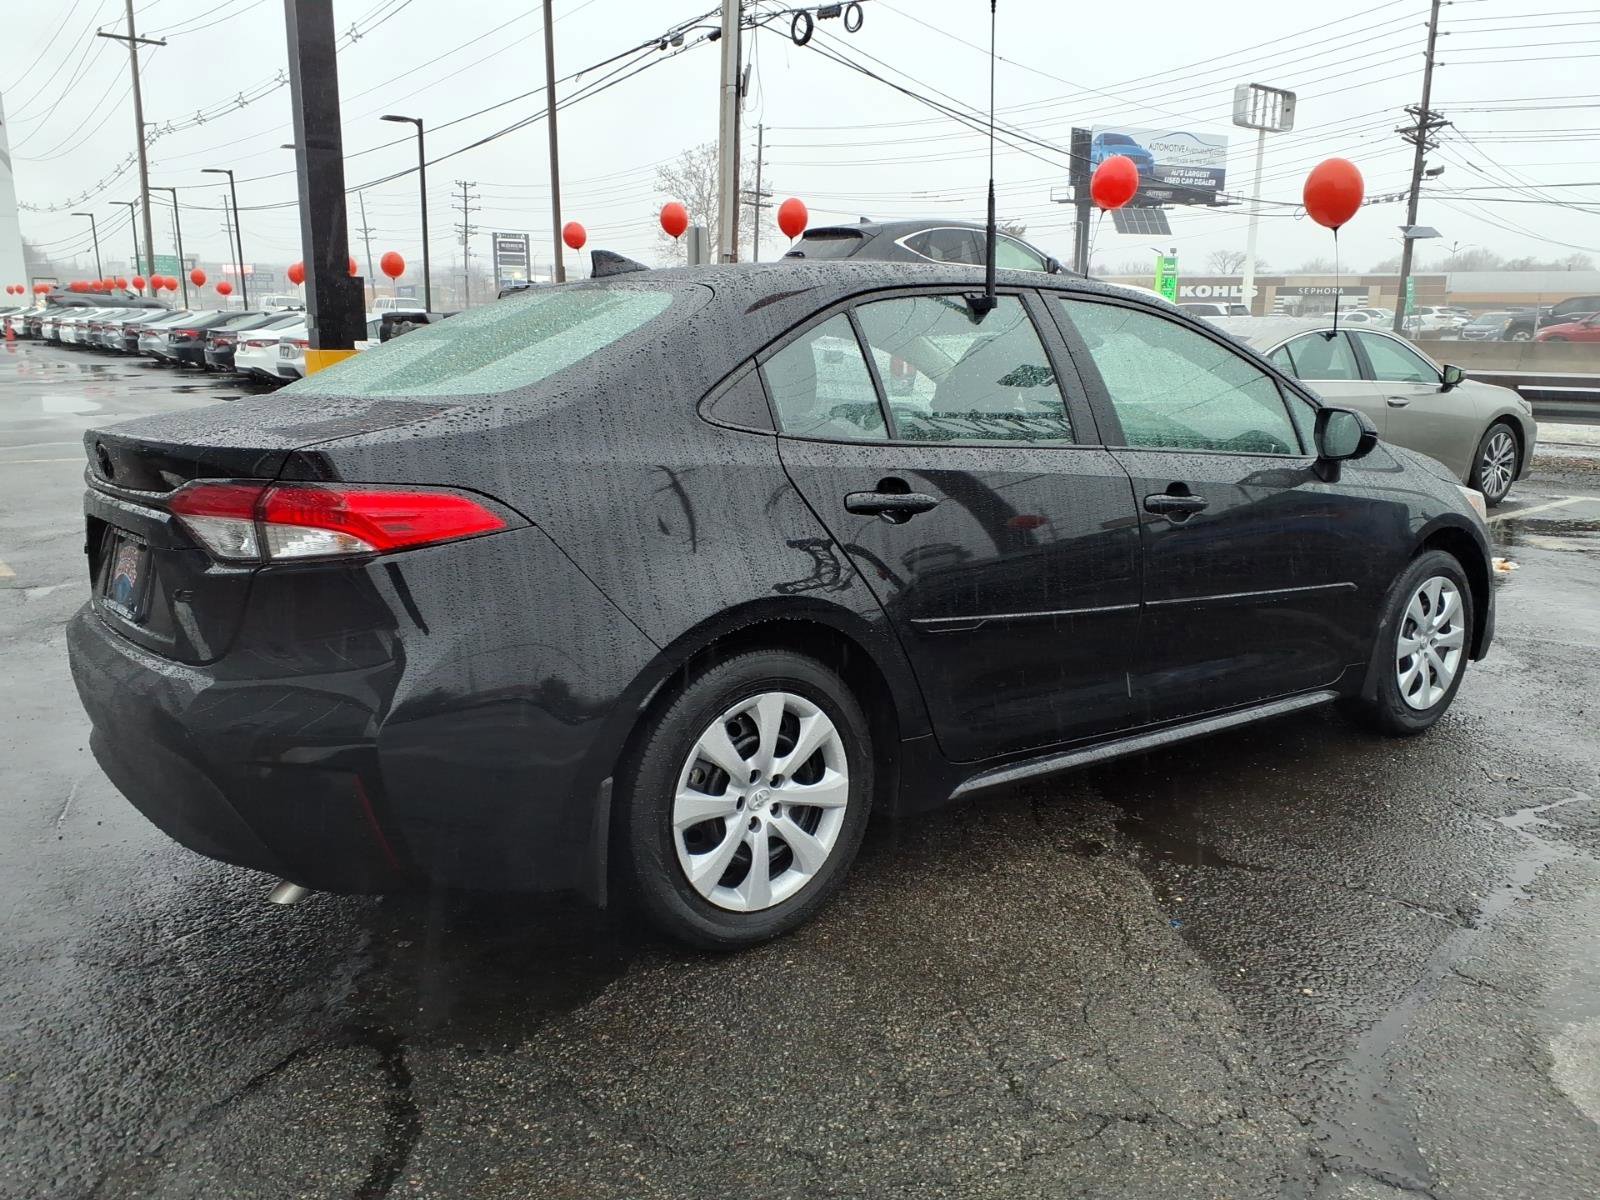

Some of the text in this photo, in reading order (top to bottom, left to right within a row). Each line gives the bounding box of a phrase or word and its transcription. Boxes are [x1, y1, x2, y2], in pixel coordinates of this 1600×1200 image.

[1185, 170, 1210, 178] LARGEST
[1164, 176, 1180, 184] USED
[1194, 178, 1216, 186] DEALER
[1297, 287, 1344, 295] SEPHORA
